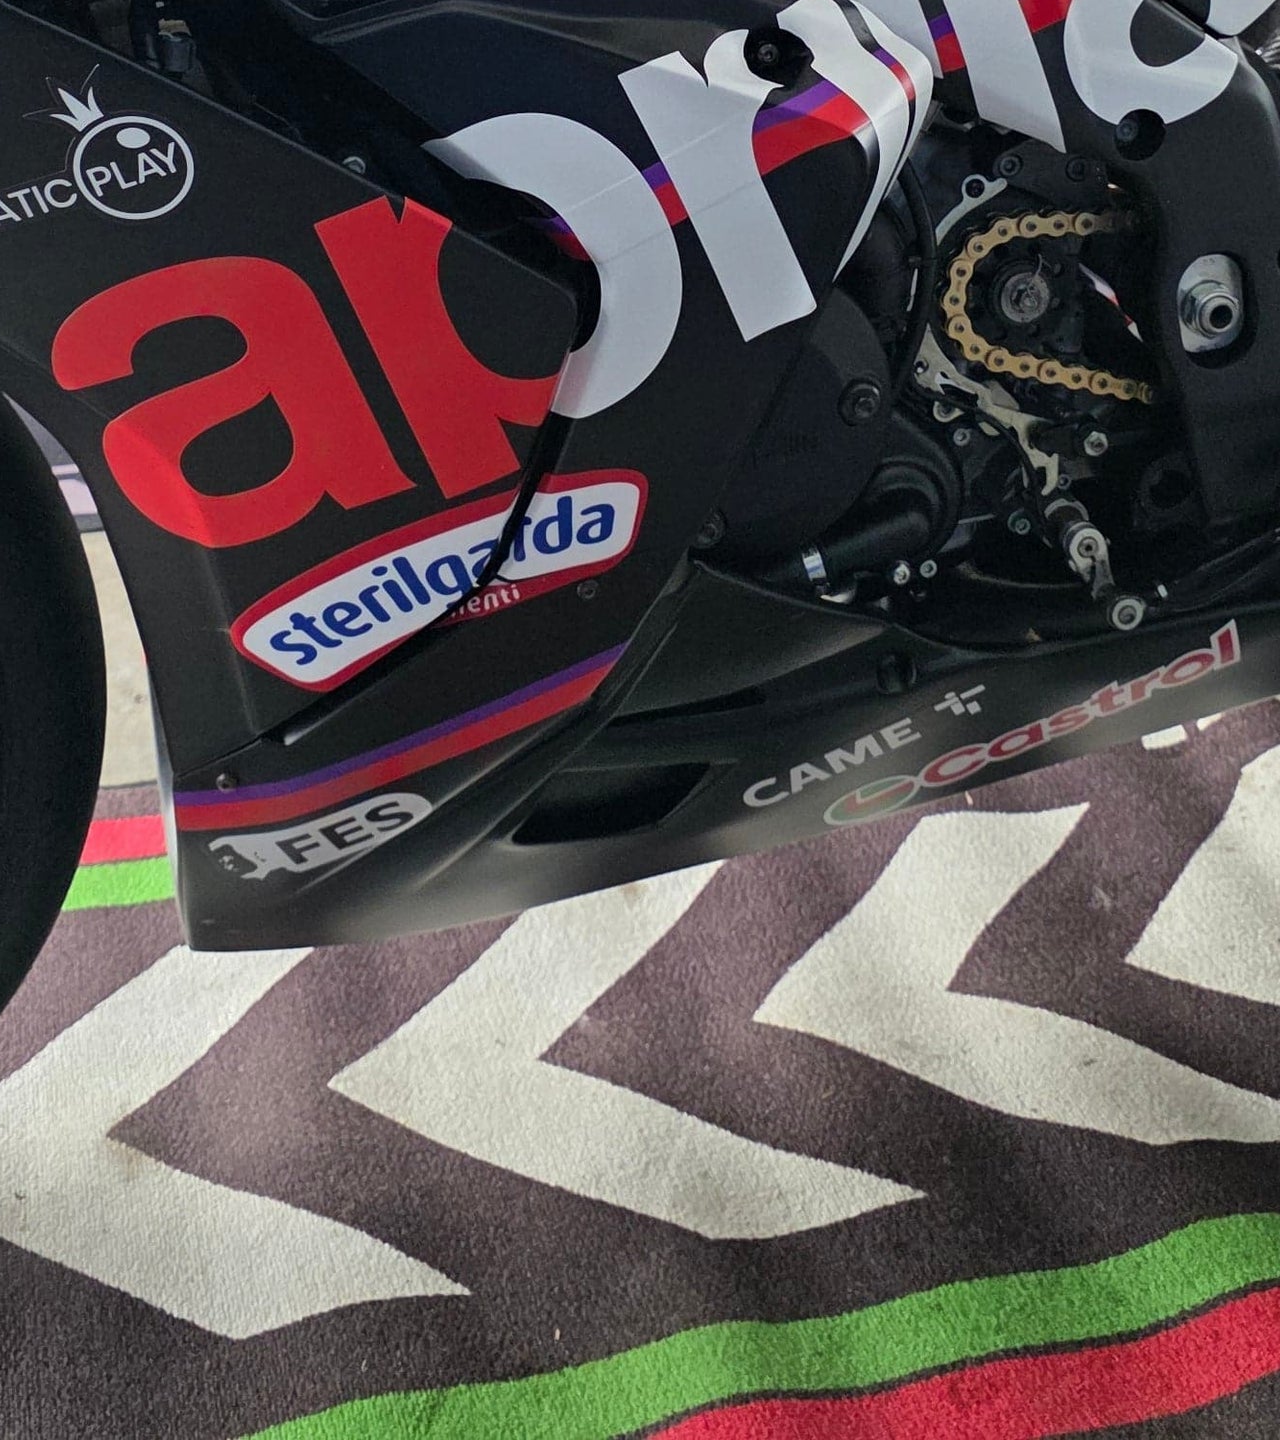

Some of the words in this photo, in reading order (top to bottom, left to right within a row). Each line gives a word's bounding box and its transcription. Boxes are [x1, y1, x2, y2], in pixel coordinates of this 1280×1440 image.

[85, 141, 182, 199] PLAY
[920, 617, 1244, 789] Castrol
[741, 717, 923, 811] CAME
